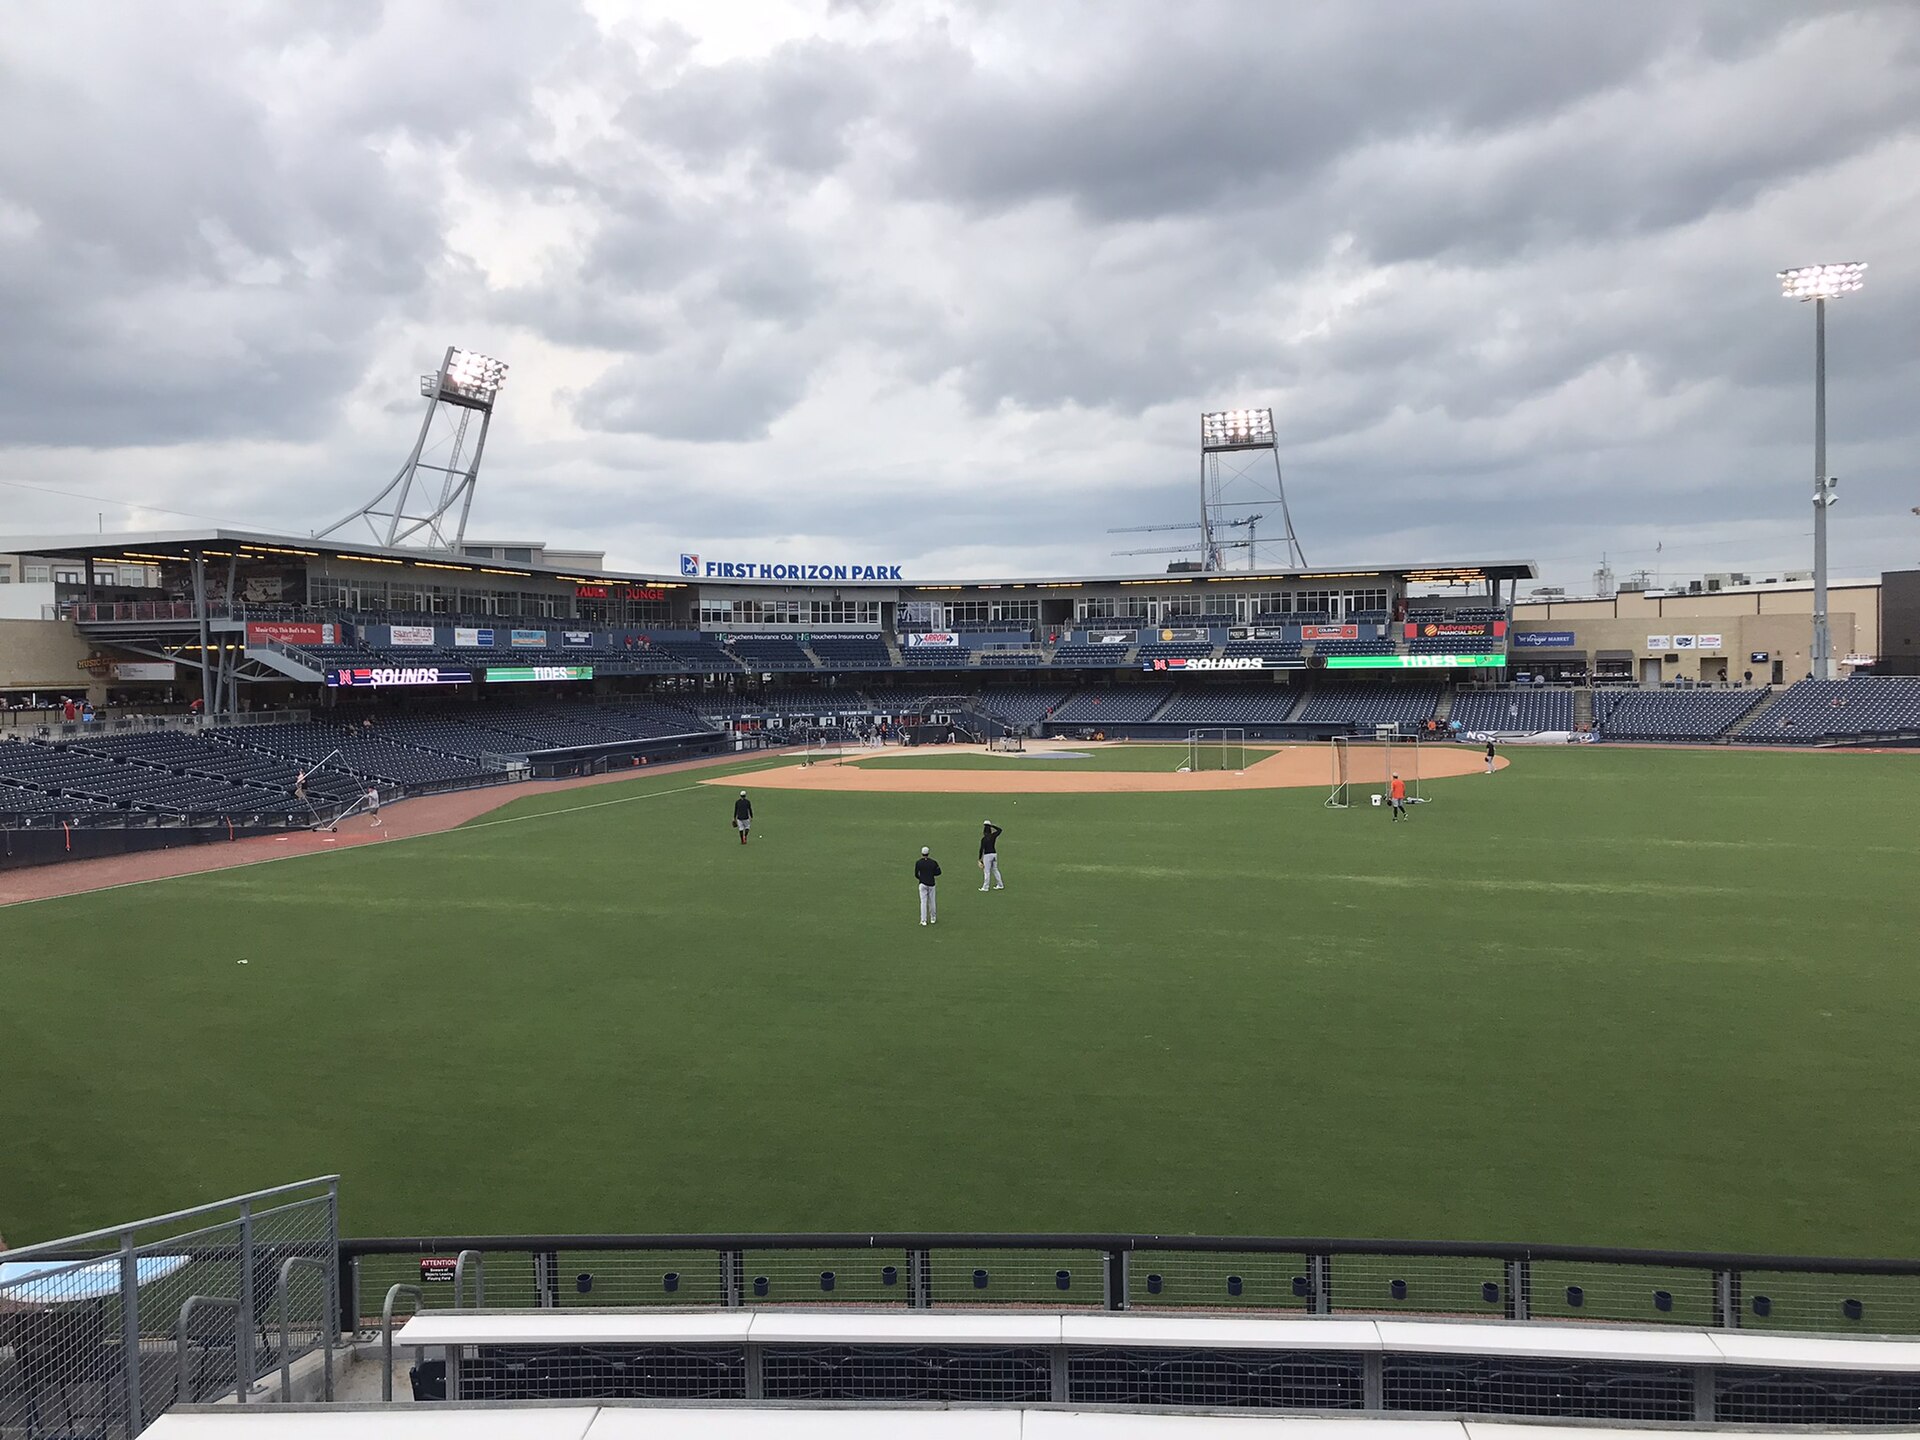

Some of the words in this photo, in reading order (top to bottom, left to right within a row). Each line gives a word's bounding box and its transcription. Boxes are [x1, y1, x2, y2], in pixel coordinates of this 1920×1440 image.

[706, 562, 756, 577] FIRST
[760, 564, 847, 580] HORIZON
[852, 565, 903, 580] PARK
[924, 634, 947, 642] ARROW
[1527, 634, 1547, 645] Kroger
[1185, 658, 1263, 670] SOUNDS
[1398, 655, 1458, 667] TIDES
[371, 668, 439, 684] SOUNDS
[533, 667, 566, 680] TIDES
